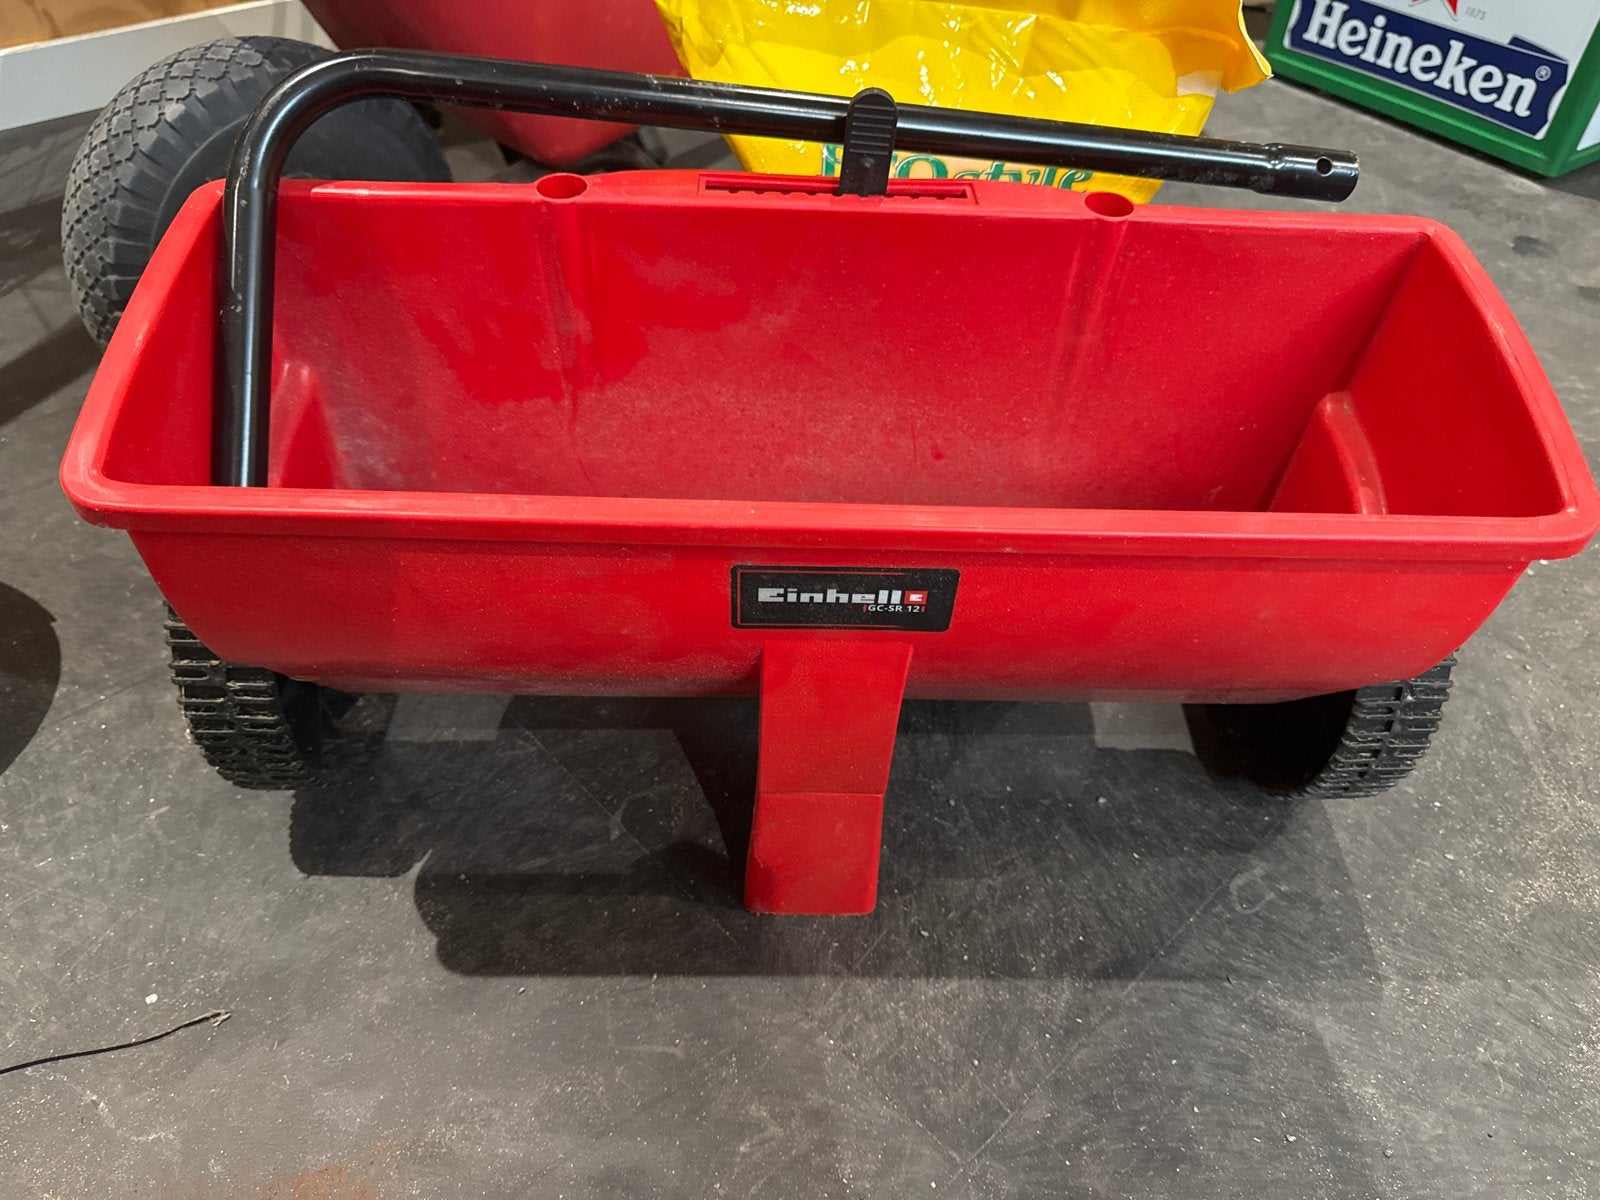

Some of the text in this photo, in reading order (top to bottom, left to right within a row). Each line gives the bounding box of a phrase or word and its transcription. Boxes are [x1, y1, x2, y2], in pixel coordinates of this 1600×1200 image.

[1302, 0, 1538, 118] Heineken
[758, 587, 902, 604] Einhell
[868, 604, 920, 613] GC-SR 12
